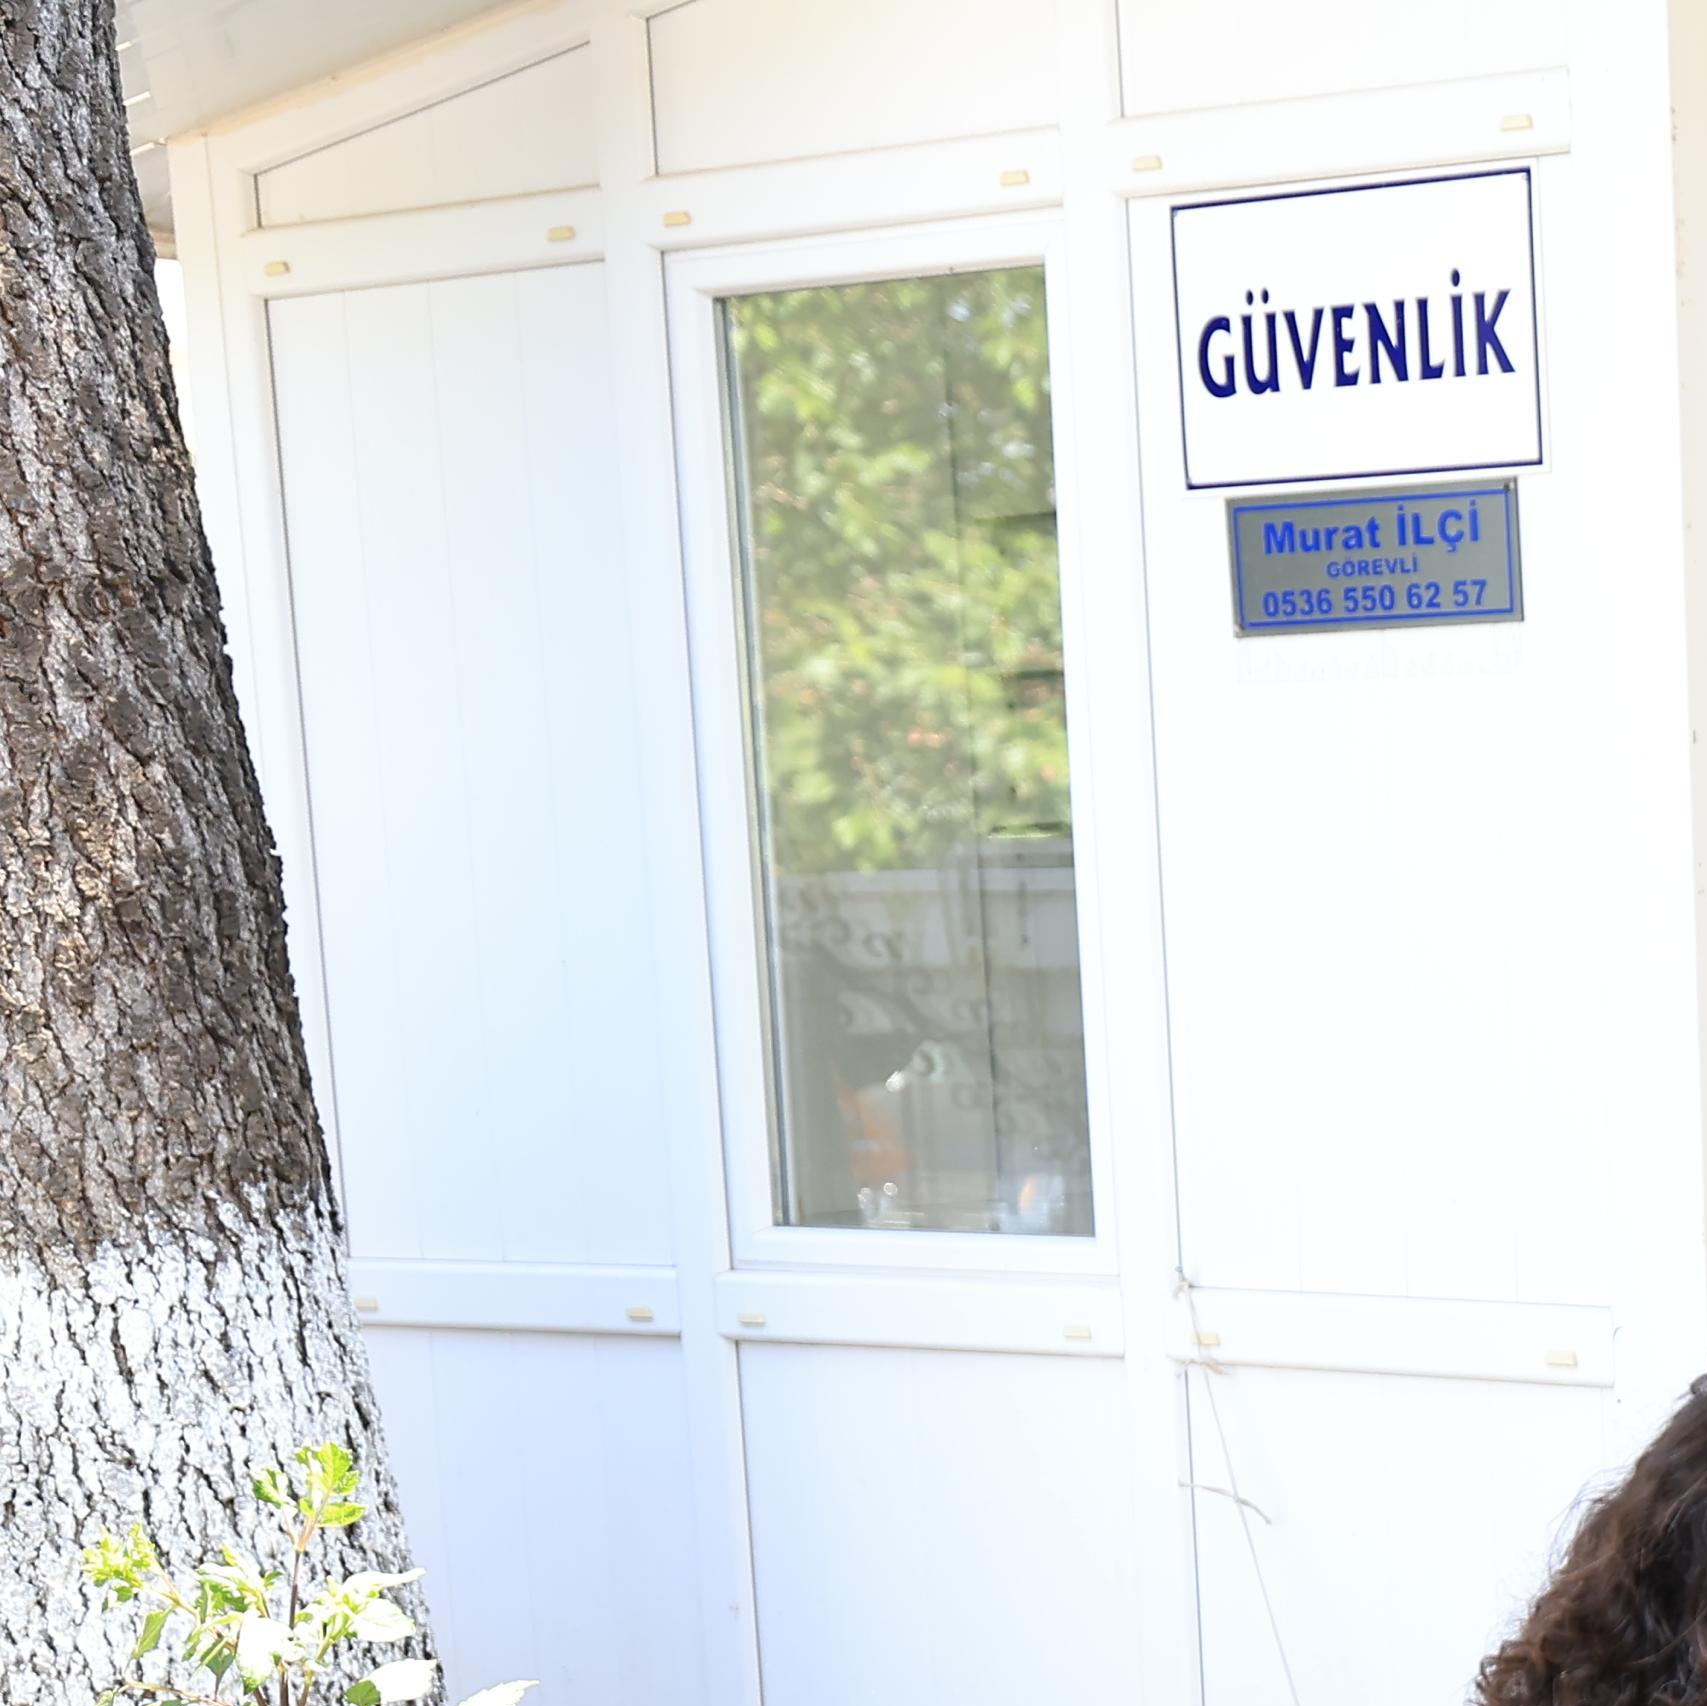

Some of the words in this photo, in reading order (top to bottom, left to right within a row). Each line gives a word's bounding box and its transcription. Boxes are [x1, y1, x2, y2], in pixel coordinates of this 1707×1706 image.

[1197, 267, 1515, 398] GÜVENLİK
[1263, 515, 1381, 554] Murat
[1397, 499, 1479, 553] İLÇİ
[1326, 553, 1418, 578] GÖREVLİ
[1263, 588, 1333, 617] 0536
[1343, 585, 1395, 613] 550
[1406, 581, 1442, 609] 62
[1453, 579, 1488, 607] 57
